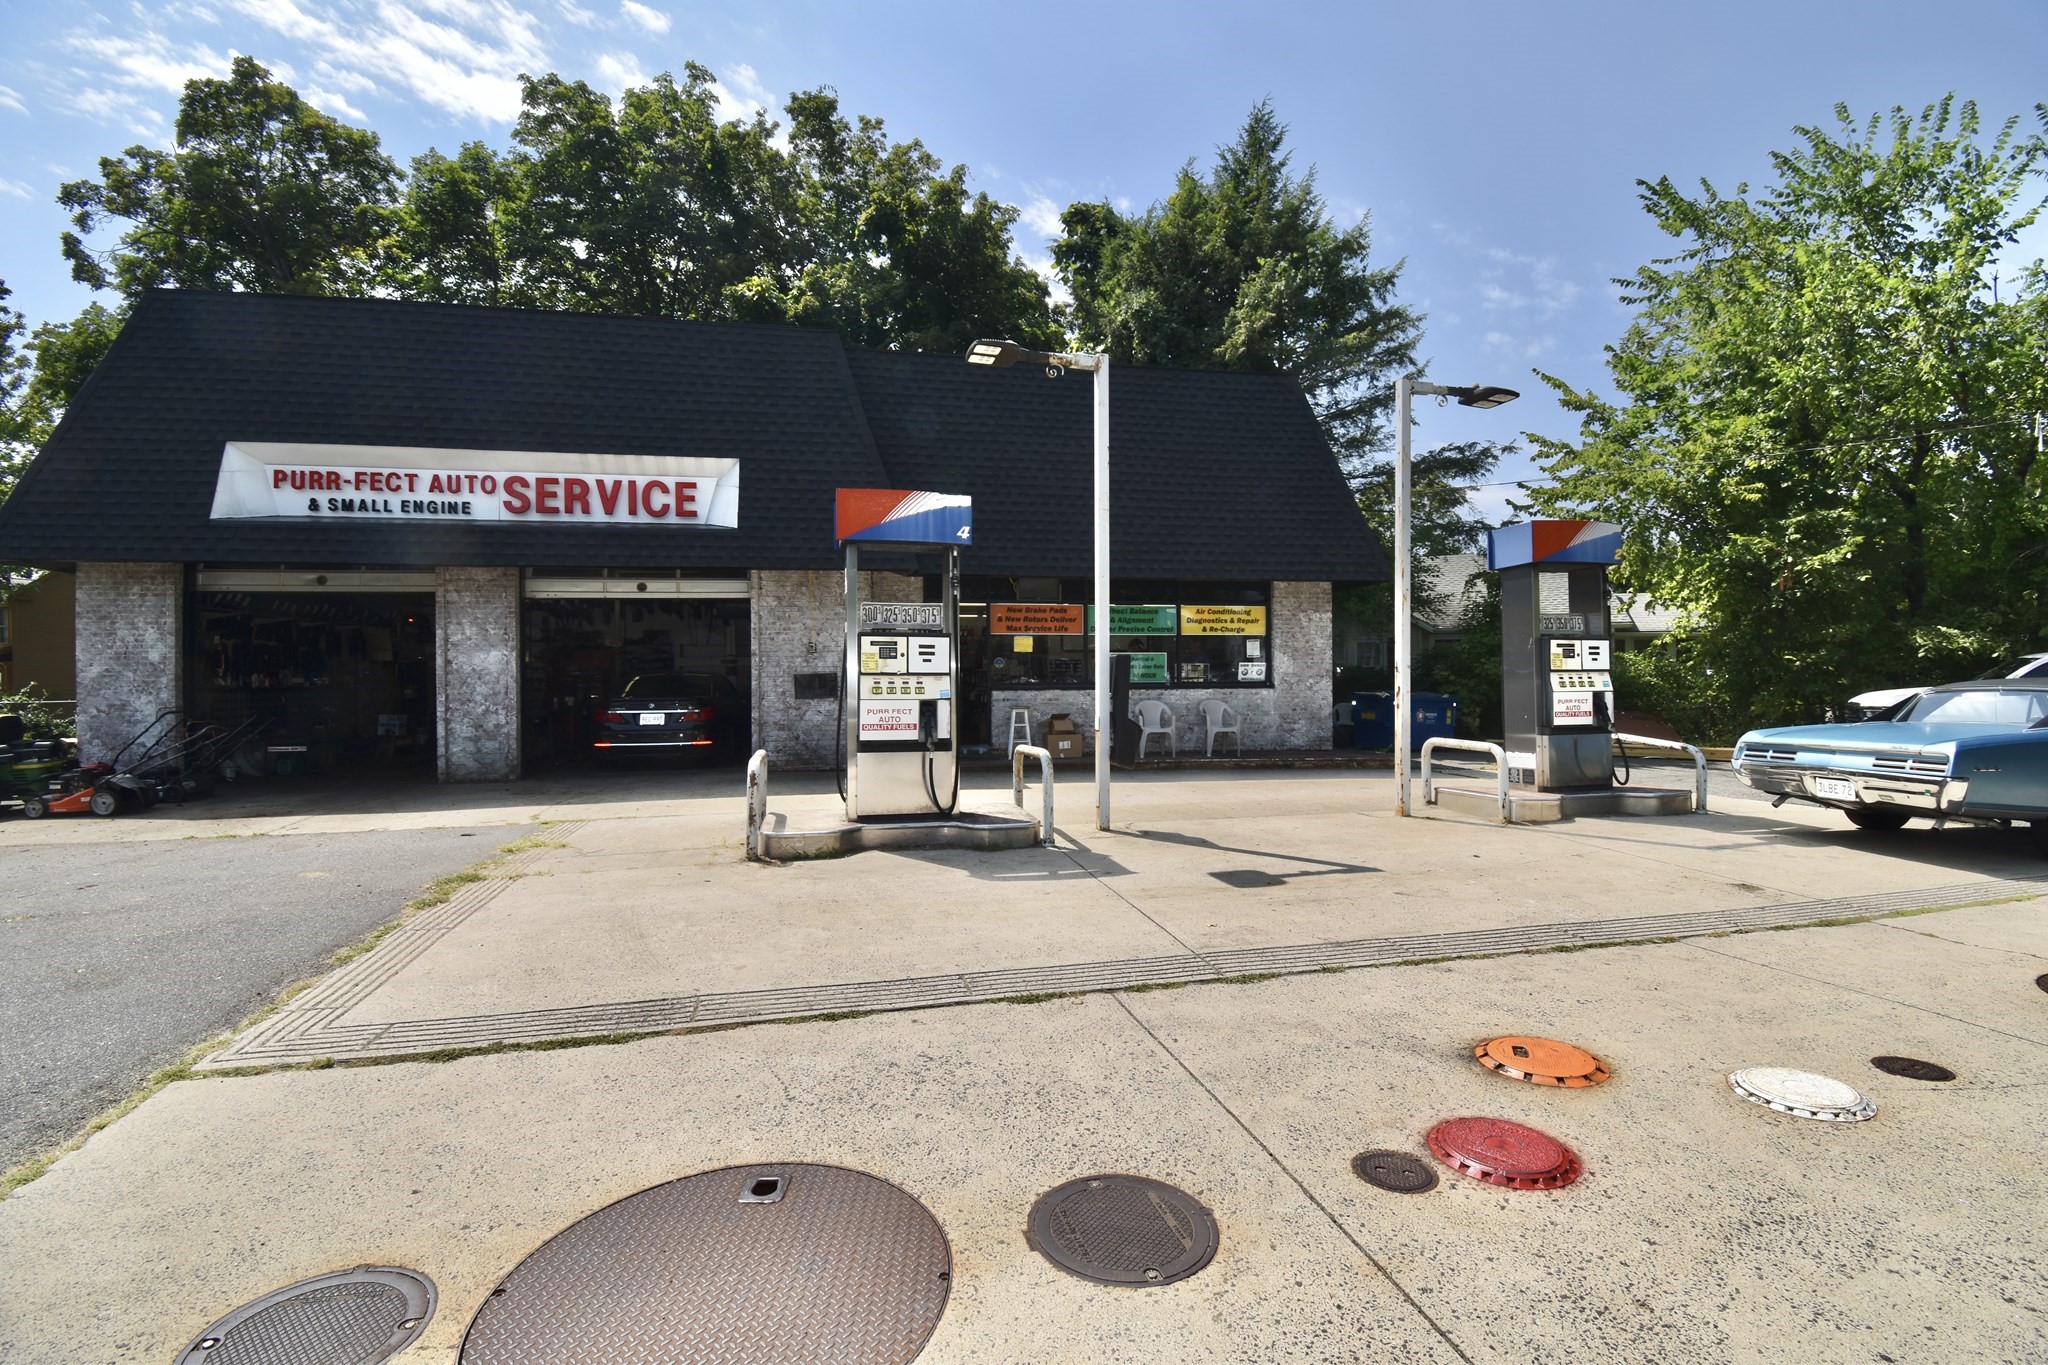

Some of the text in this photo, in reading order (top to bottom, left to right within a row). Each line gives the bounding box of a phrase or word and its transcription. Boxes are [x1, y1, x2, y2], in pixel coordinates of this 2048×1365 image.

[273, 469, 698, 518] PURR-FECT AUTO SERVICE
[308, 497, 472, 514] & SMALL ENGINE
[956, 525, 971, 540] 4
[1006, 606, 1068, 614] New Brake Pads
[1207, 608, 1252, 616] Conditioning
[1117, 617, 1154, 625] Alignment
[1186, 617, 1228, 625] Diagnostics
[1209, 626, 1245, 634] Re-Charge
[866, 708, 889, 716] PURR
